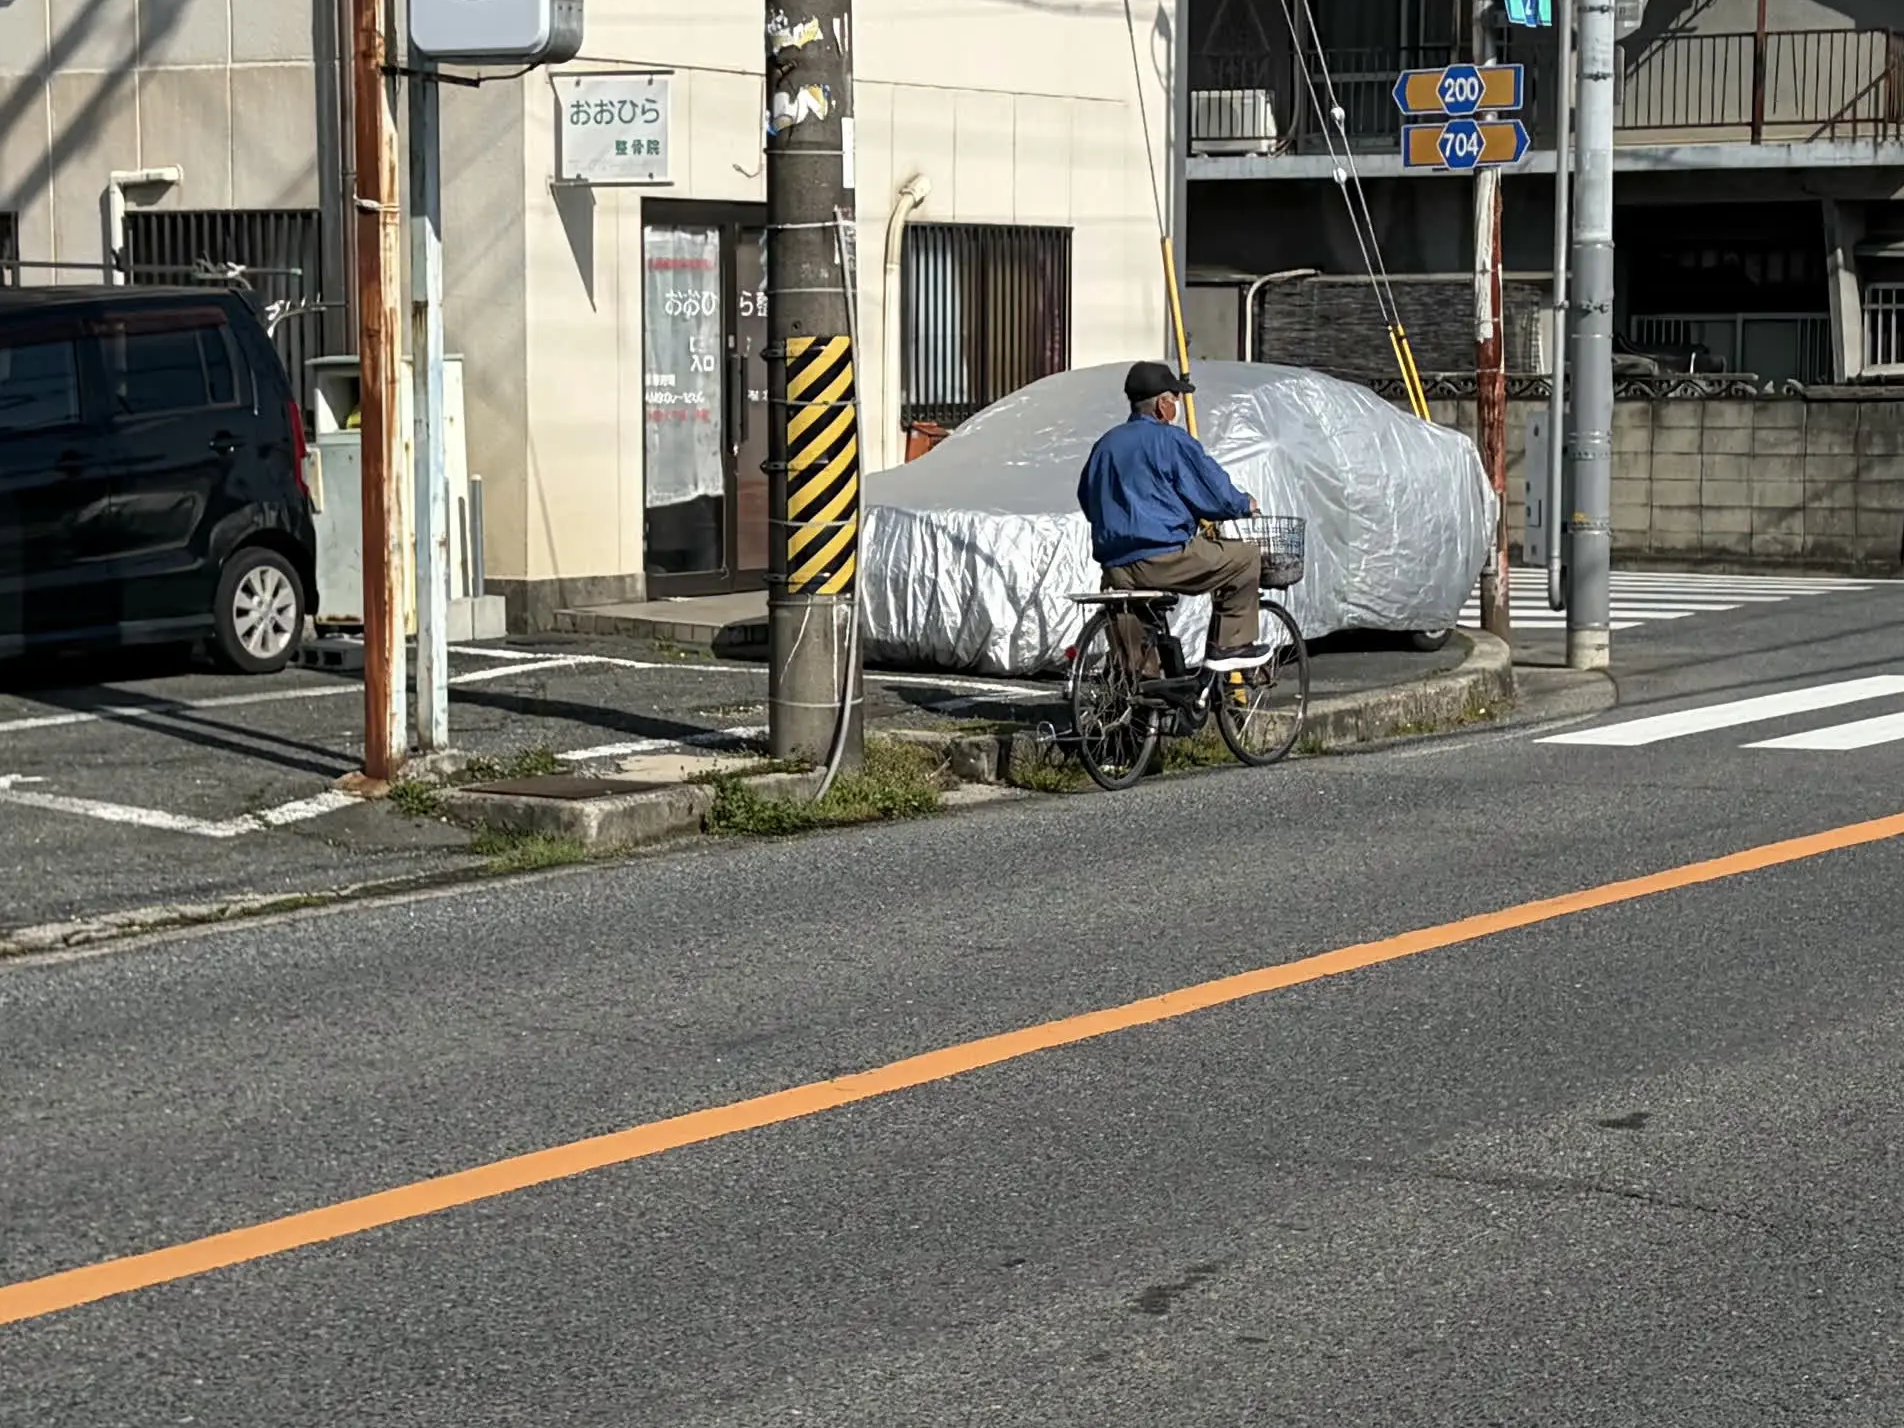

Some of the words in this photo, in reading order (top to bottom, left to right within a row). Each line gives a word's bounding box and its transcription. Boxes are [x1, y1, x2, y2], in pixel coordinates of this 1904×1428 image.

[1443, 76, 1480, 103] 200
[570, 98, 660, 126] おおひら
[615, 139, 660, 156] 整骨院
[1443, 132, 1479, 158] 704
[690, 354, 715, 373] 入口
